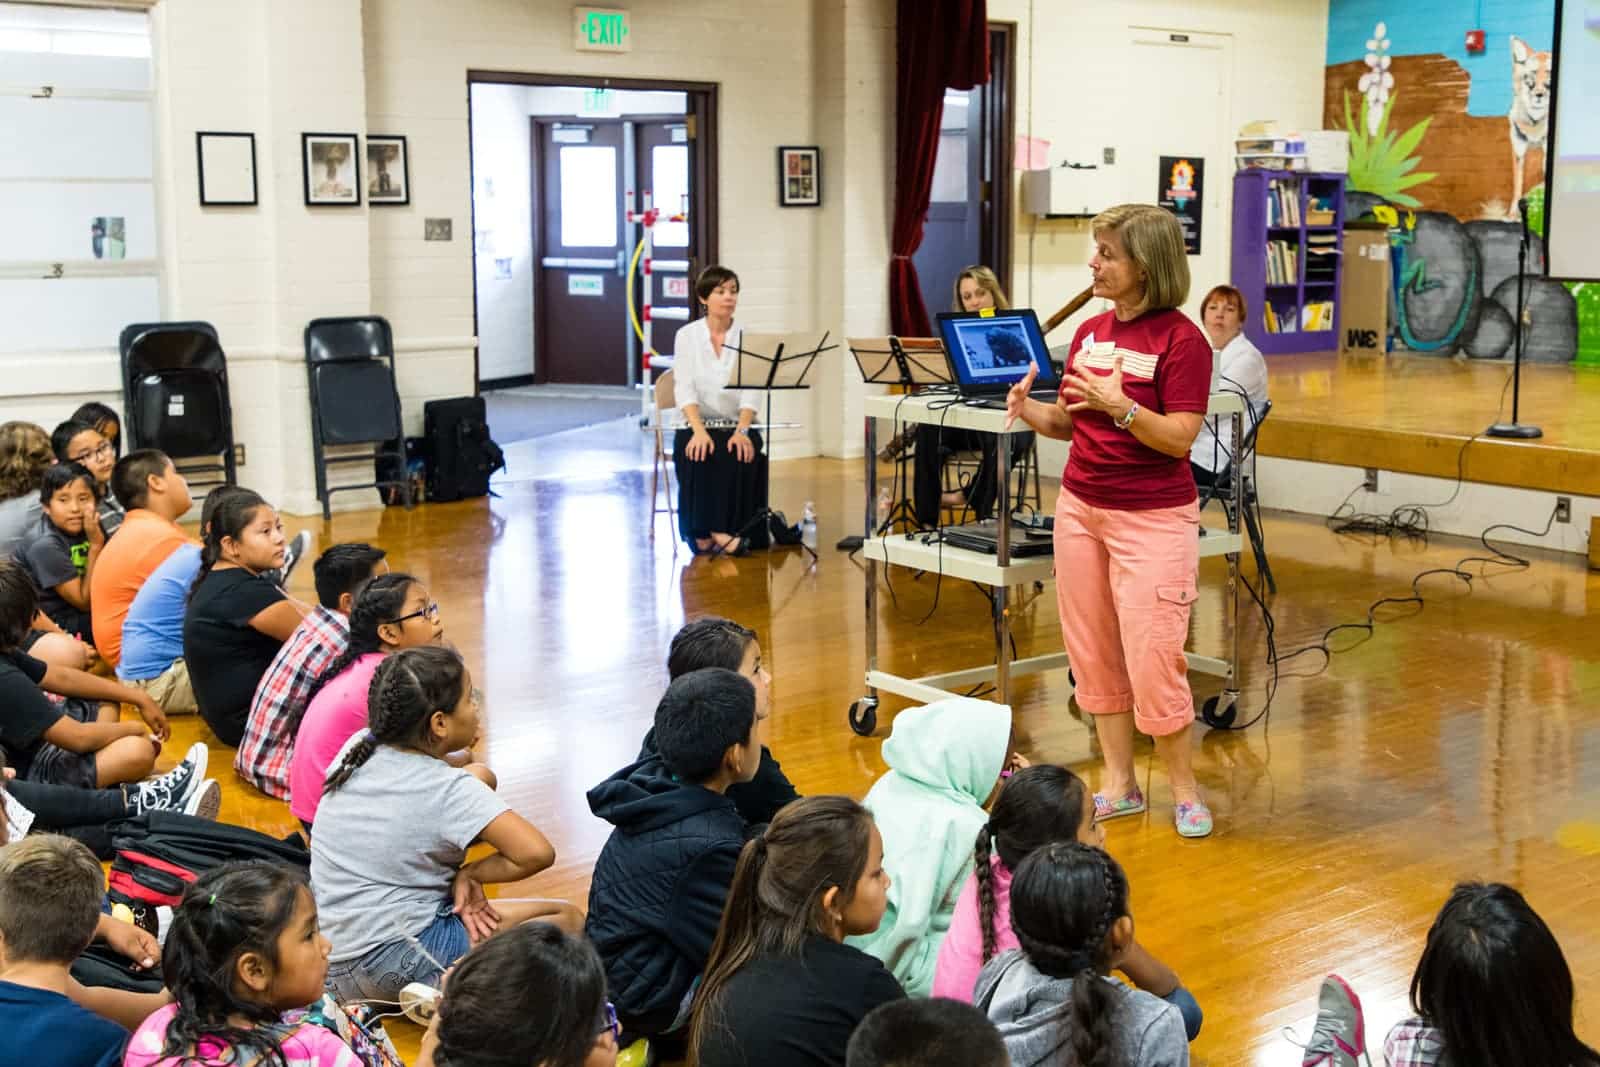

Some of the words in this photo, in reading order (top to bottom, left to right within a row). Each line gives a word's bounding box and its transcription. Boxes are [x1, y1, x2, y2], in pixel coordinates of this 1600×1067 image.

[587, 12, 624, 45] EXIT
[583, 89, 613, 112] EXIT
[1347, 329, 1377, 348] 3M
